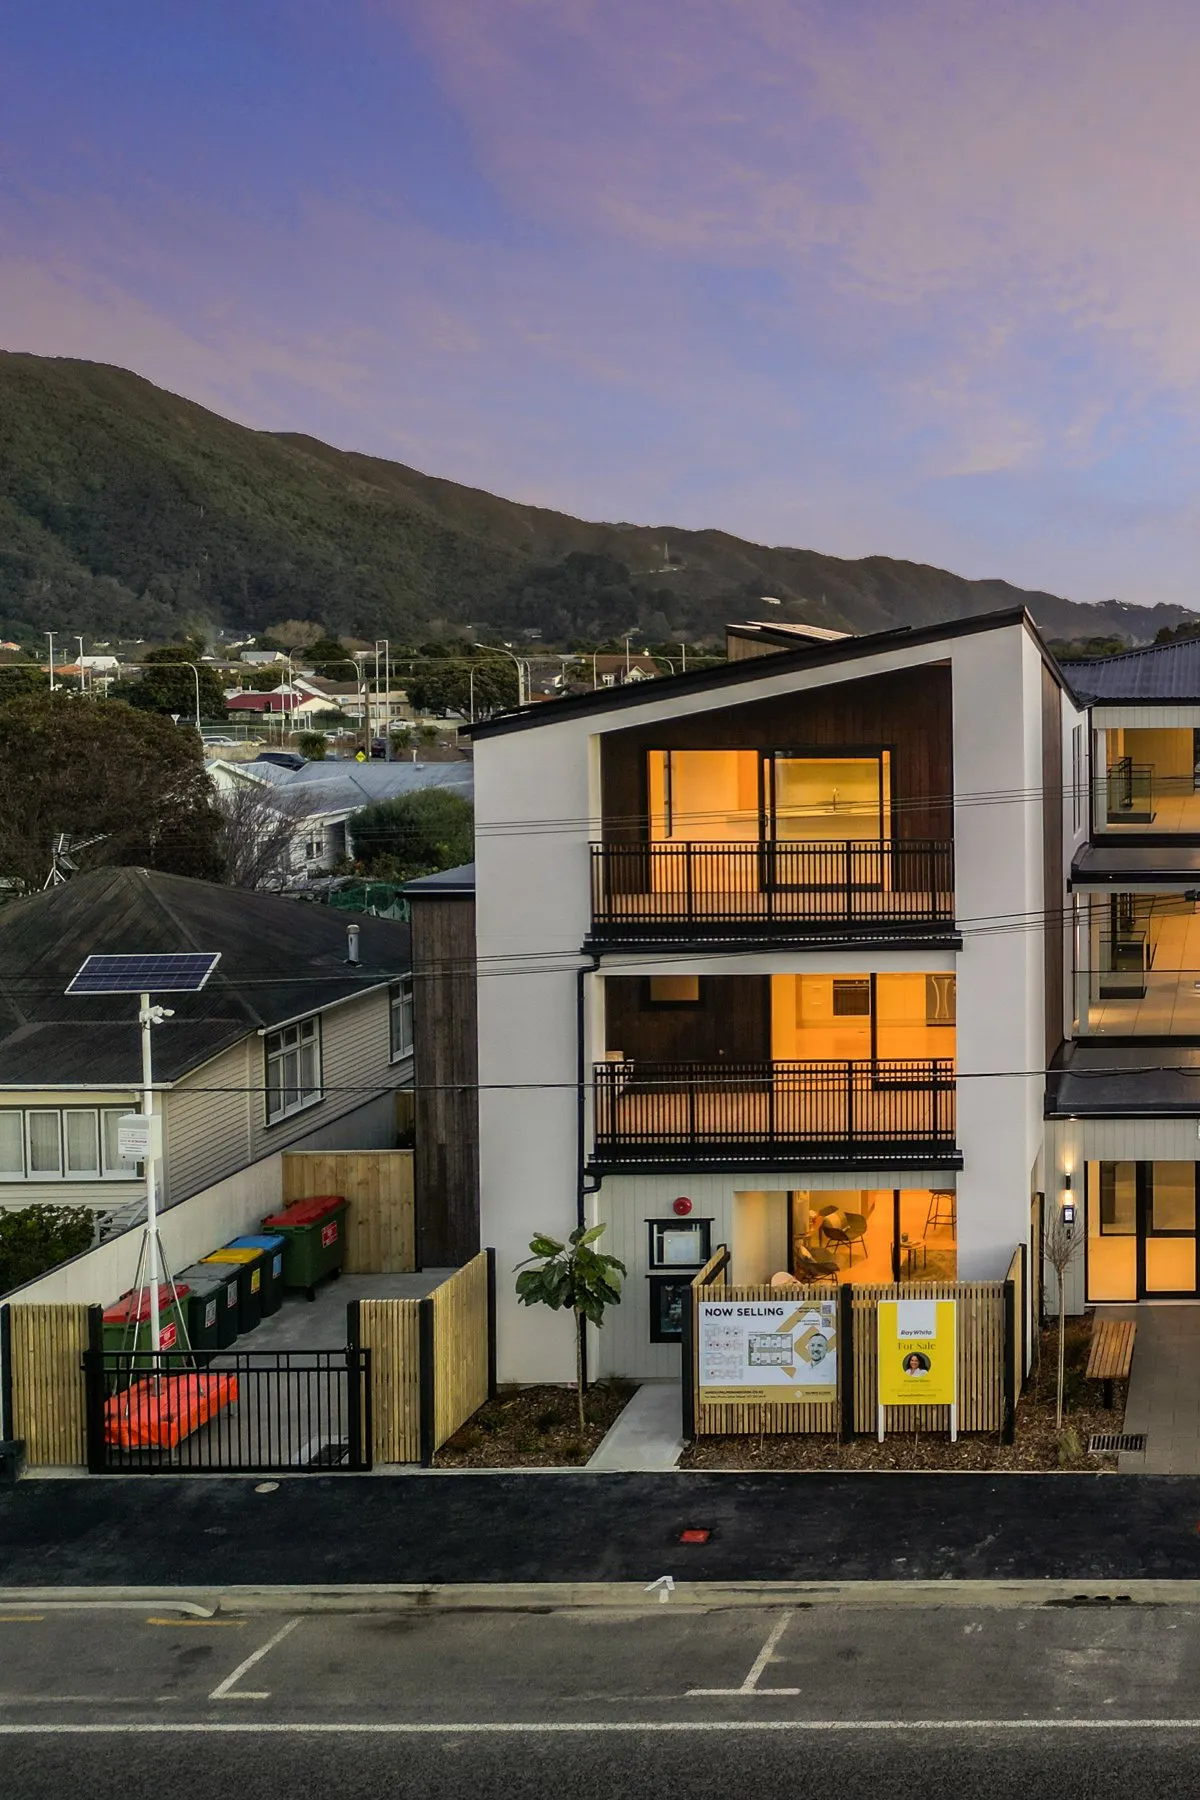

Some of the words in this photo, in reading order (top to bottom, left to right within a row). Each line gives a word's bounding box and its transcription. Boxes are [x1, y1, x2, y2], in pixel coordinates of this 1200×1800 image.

[705, 1307, 733, 1316] NOW
[737, 1307, 784, 1316] SELLING
[898, 1341, 912, 1350] For
[916, 1341, 936, 1350] Sale
